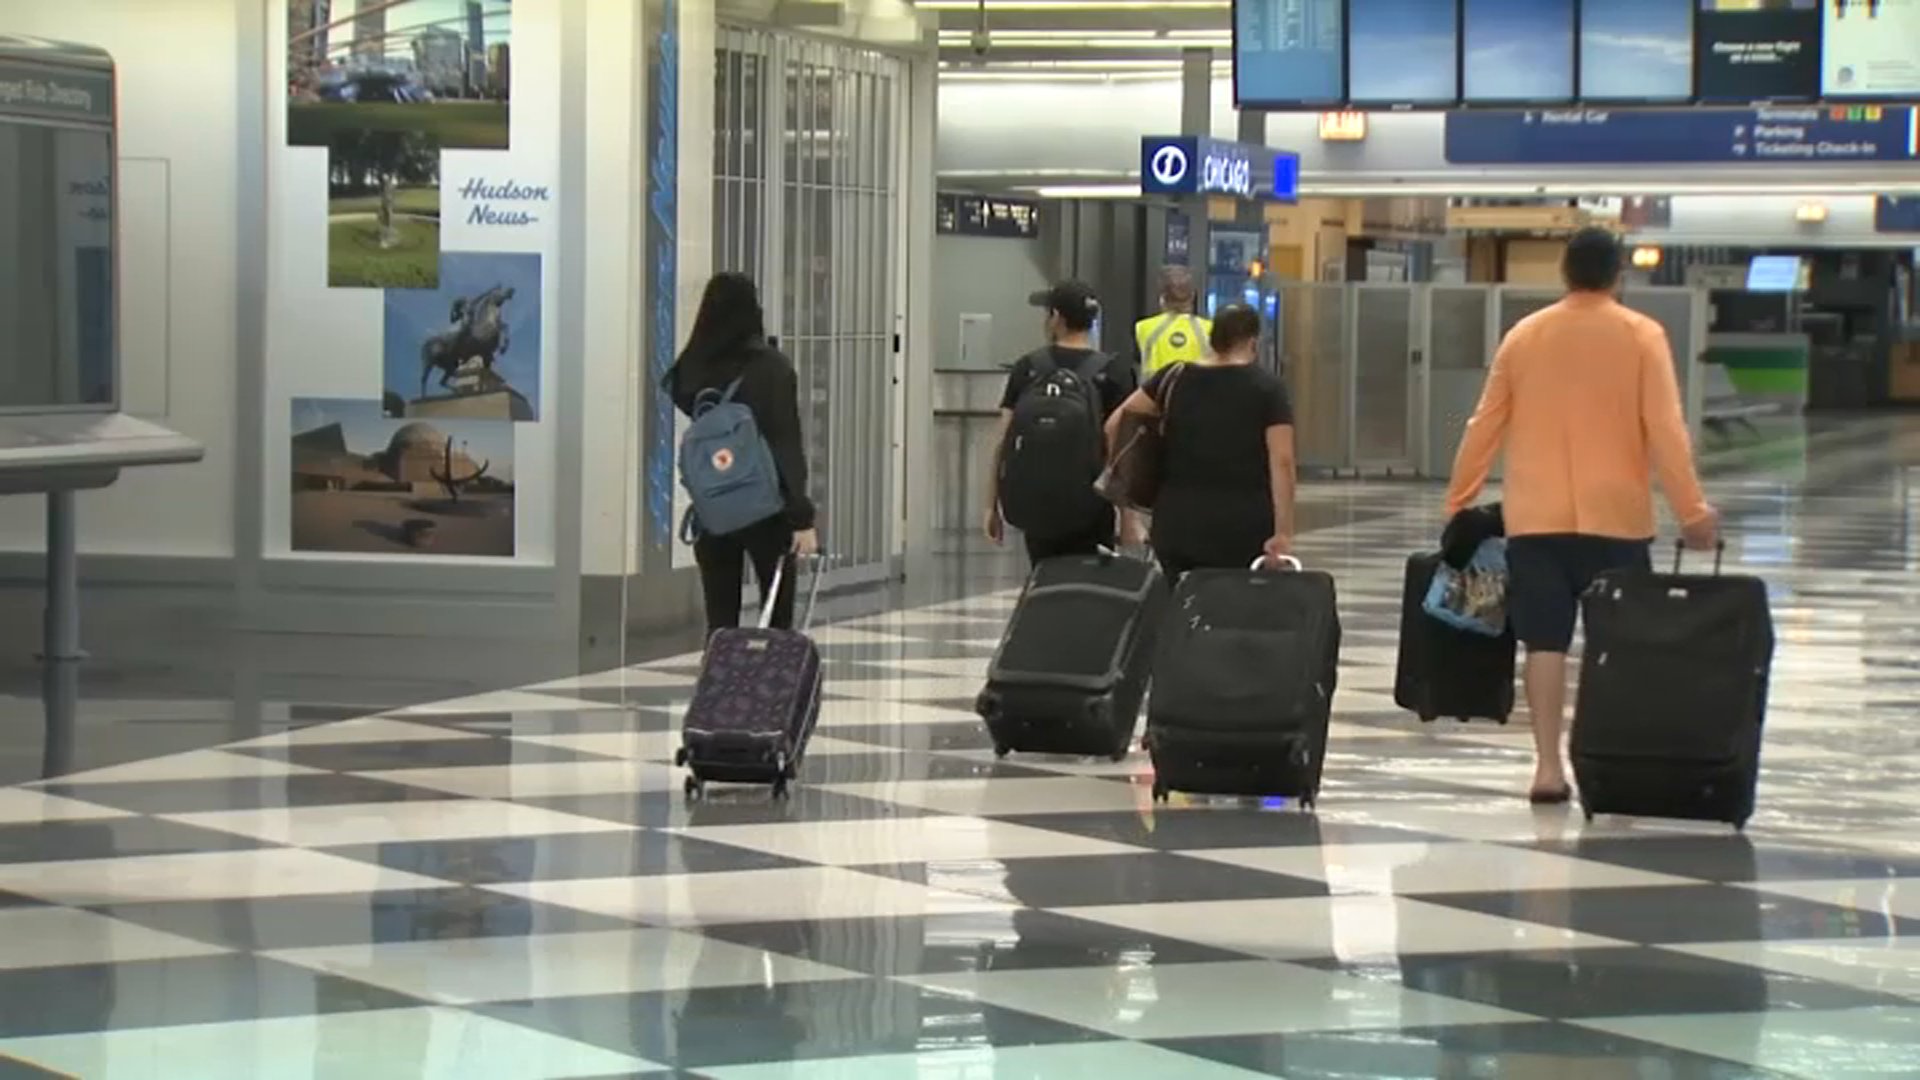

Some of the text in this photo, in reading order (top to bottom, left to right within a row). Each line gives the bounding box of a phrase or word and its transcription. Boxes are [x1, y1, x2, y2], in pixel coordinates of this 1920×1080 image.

[1542, 109, 1608, 124] Rental Car
[1754, 125, 1804, 140] Parking
[1755, 141, 1814, 156] Ticketing
[1204, 155, 1249, 194] CHICAGO
[458, 177, 548, 201] Hudson
[467, 203, 539, 225] News
